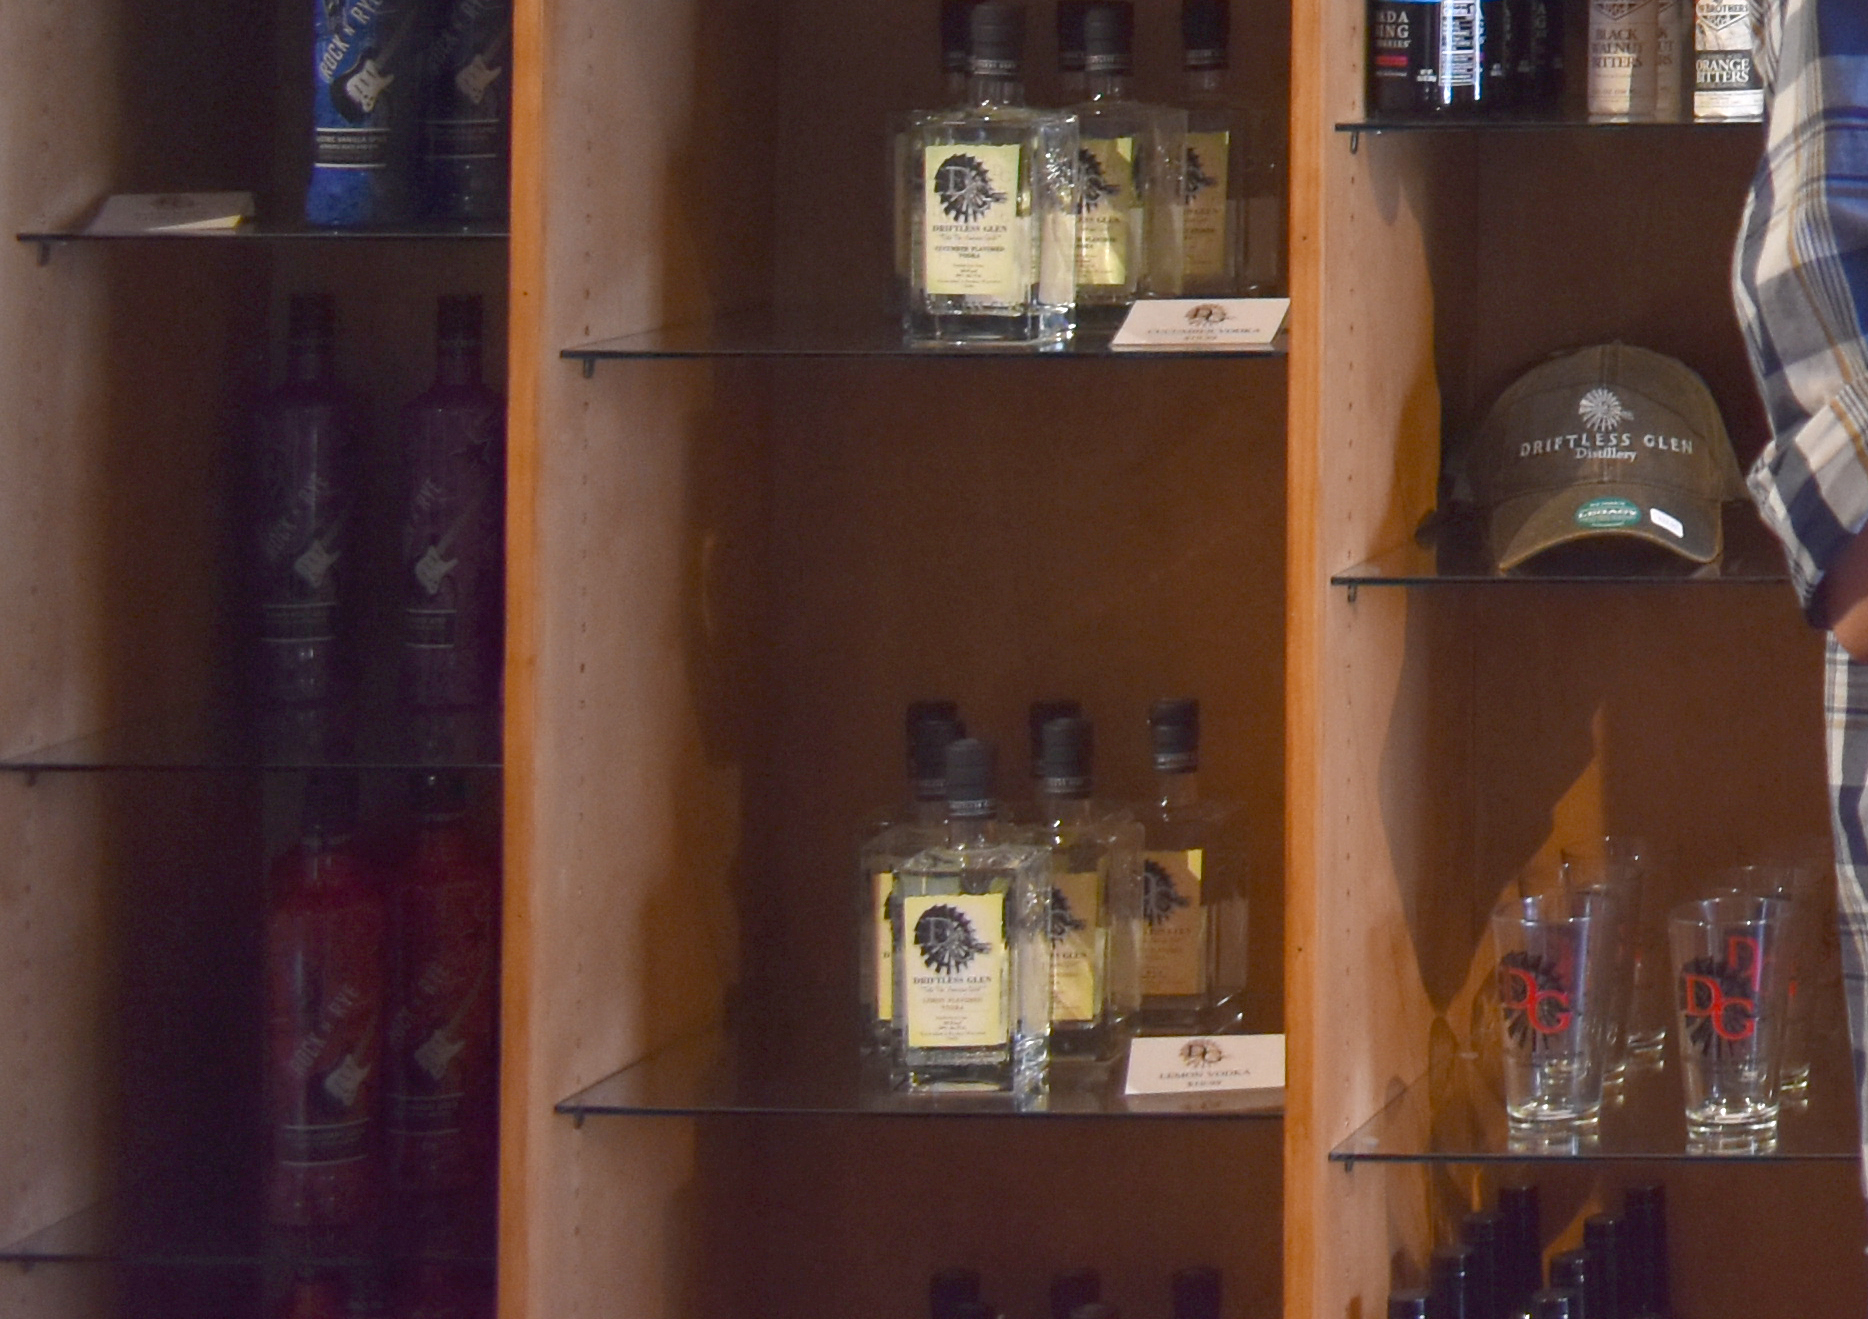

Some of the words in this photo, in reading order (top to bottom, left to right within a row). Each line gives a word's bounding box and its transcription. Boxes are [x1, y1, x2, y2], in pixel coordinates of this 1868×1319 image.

[1706, 4, 1750, 14] BROTHERS
[1597, 28, 1637, 40] BLACK
[1592, 41, 1640, 53] WALNUT
[320, 35, 350, 81] ROCK
[1594, 55, 1642, 68] BITTERS
[1695, 59, 1751, 72] ORANGE
[1520, 433, 1632, 458] DRIFTLESS
[1643, 434, 1693, 455] GLEN
[1575, 446, 1637, 464] Distillery
[1499, 966, 1574, 1035] DG
[1685, 973, 1756, 1041] DG
